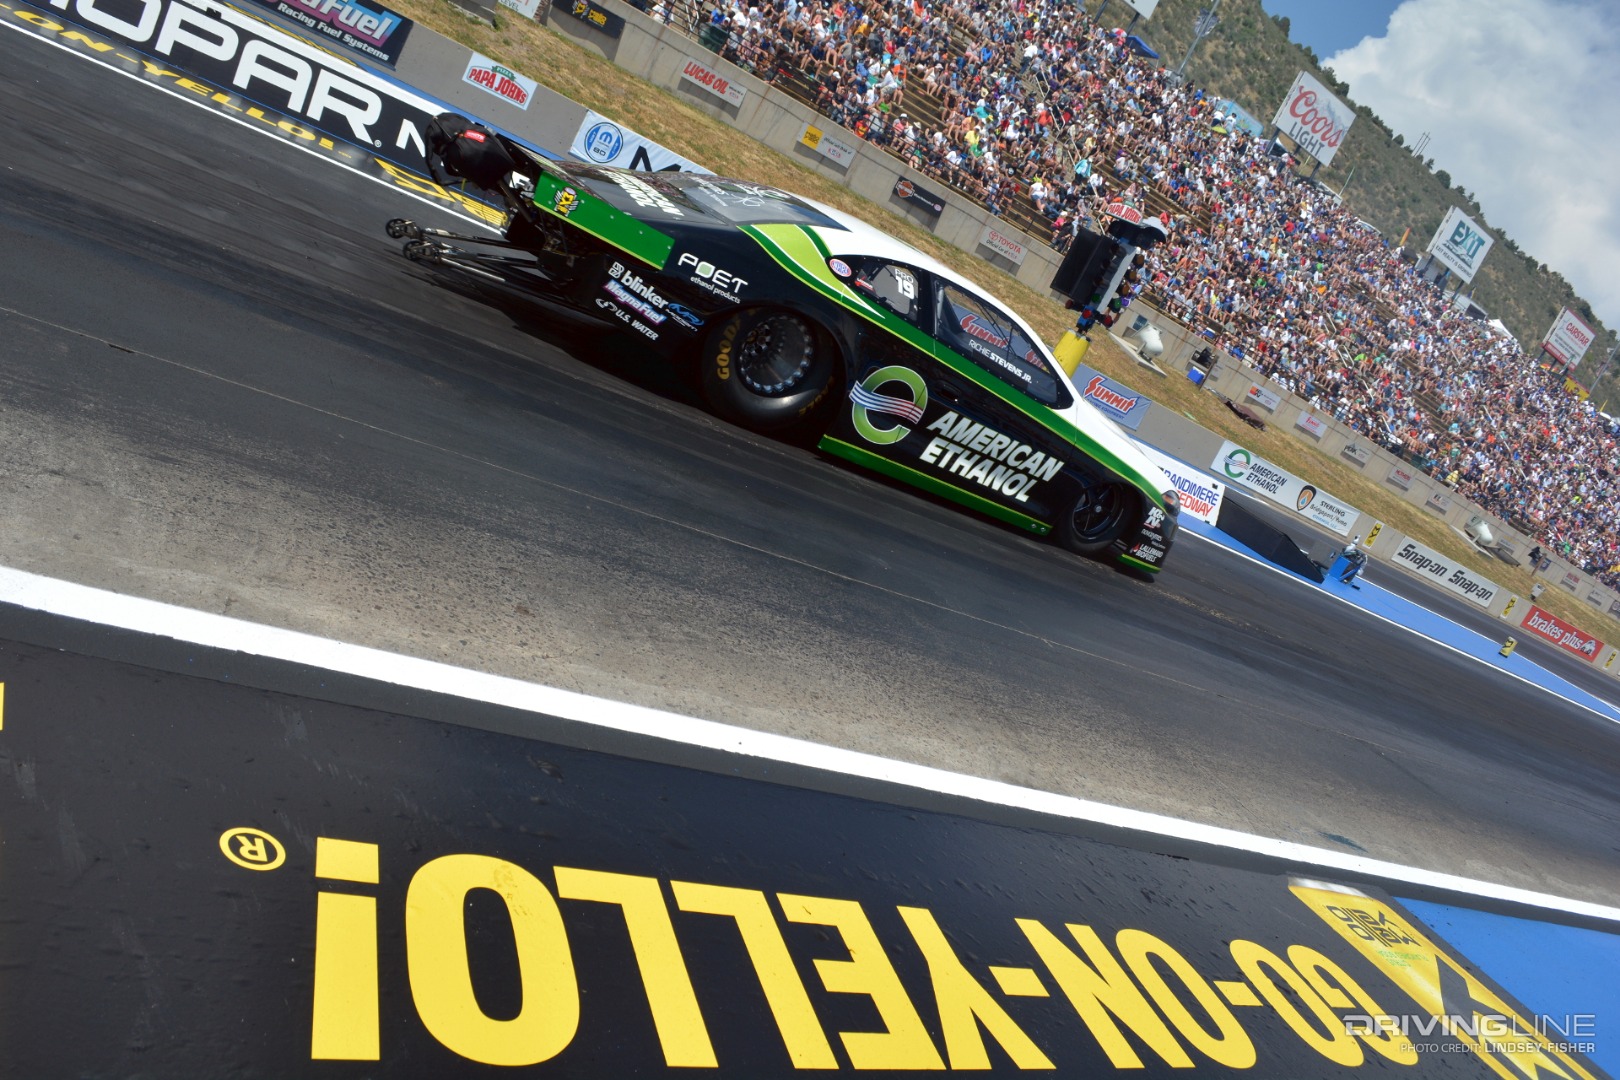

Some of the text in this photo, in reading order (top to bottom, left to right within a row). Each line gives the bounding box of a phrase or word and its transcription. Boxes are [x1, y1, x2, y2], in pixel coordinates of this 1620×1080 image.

[277, 2, 390, 61] Racing Fuel Systems
[47, 0, 374, 145] OPAR
[468, 68, 497, 88] PAPA
[683, 61, 716, 86] LUCAS
[712, 77, 729, 94] OIL
[1289, 85, 1343, 147] Coors
[1288, 121, 1325, 157] LIGHT
[999, 236, 1021, 254] TOYOTA
[620, 270, 669, 309] blinker
[677, 252, 748, 293] POET
[690, 276, 741, 304] ethanol products
[895, 268, 914, 283] PRO
[896, 276, 915, 300] 19
[604, 280, 667, 325] MagnaFuel
[630, 319, 659, 341] WATER
[1565, 322, 1590, 347] CARSTAR
[968, 339, 991, 360] RICHIE
[989, 352, 1023, 378] STEVENS
[926, 410, 1065, 482] AMERICAN
[919, 437, 1038, 503] ETHANOL
[1246, 472, 1280, 495] ETHANOL
[1250, 463, 1288, 487] AMERICAN
[1320, 500, 1346, 518] STERLING
[1397, 543, 1494, 602] Snap-on Snap-on
[1527, 611, 1584, 651] brakes plus
[312, 837, 1418, 1067] GO-ON-YELLO!
